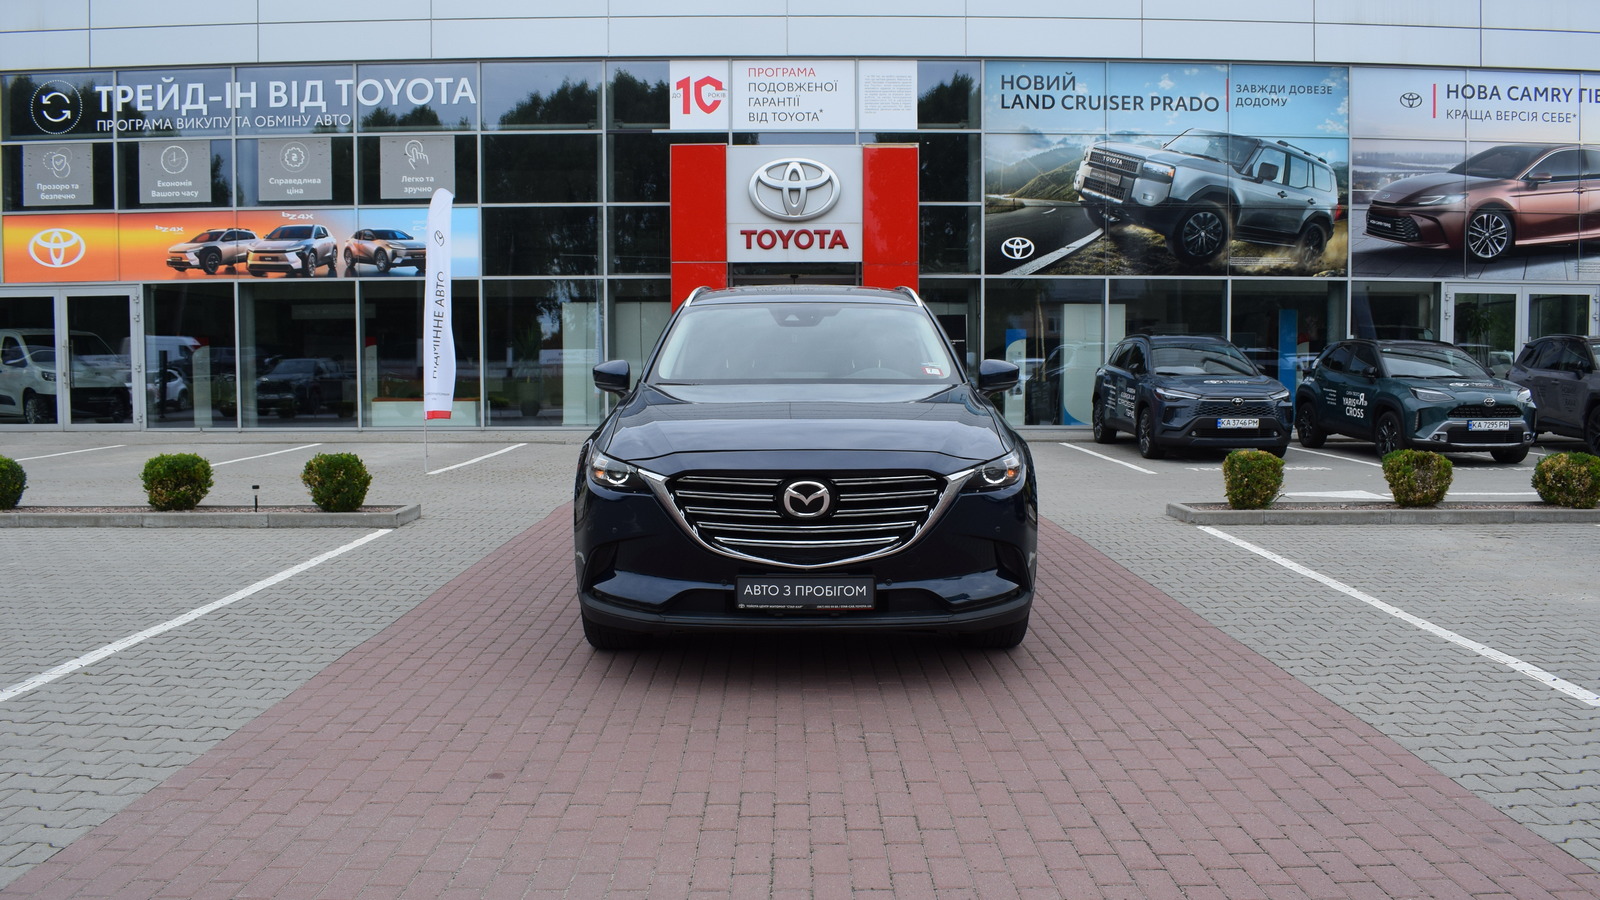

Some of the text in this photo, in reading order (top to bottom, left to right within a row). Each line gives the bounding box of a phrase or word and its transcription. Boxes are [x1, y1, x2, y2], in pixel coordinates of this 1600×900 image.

[748, 68, 816, 78] ПРОГРАМА
[748, 80, 838, 93] ПОДОВЖЕНОЇ
[1000, 72, 1076, 91] НОВИЙ
[94, 76, 477, 116] ТРЕЙД-ІН ВІД TOYOTA
[1236, 84, 1333, 96] ЗАВЖДИ ДОВЕЗЕ
[1446, 84, 1502, 100] НОВА
[1507, 86, 1572, 102] CAMRY
[748, 96, 800, 107] ГАРАНТІЇ
[1000, 94, 1220, 112] LAND CRUISER PRADO
[1236, 97, 1288, 108] ДОДОМУ
[748, 112, 768, 124] ВІД
[1446, 109, 1492, 122] КРАЩА
[1496, 111, 1538, 122] ВЕРСІЯ
[96, 114, 351, 132] ПРОГРАМА ВИКУПУ ТА ОБМІНУ АВТО
[1103, 156, 1122, 165] TOYOTA
[36, 184, 70, 192] Прозоро
[286, 187, 304, 195] ціна
[740, 229, 848, 250] TOYOTA
[434, 271, 445, 307] АВТО
[1346, 406, 1364, 418] CROSS
[744, 584, 867, 596] АВТО З ПРОБІГОМ
